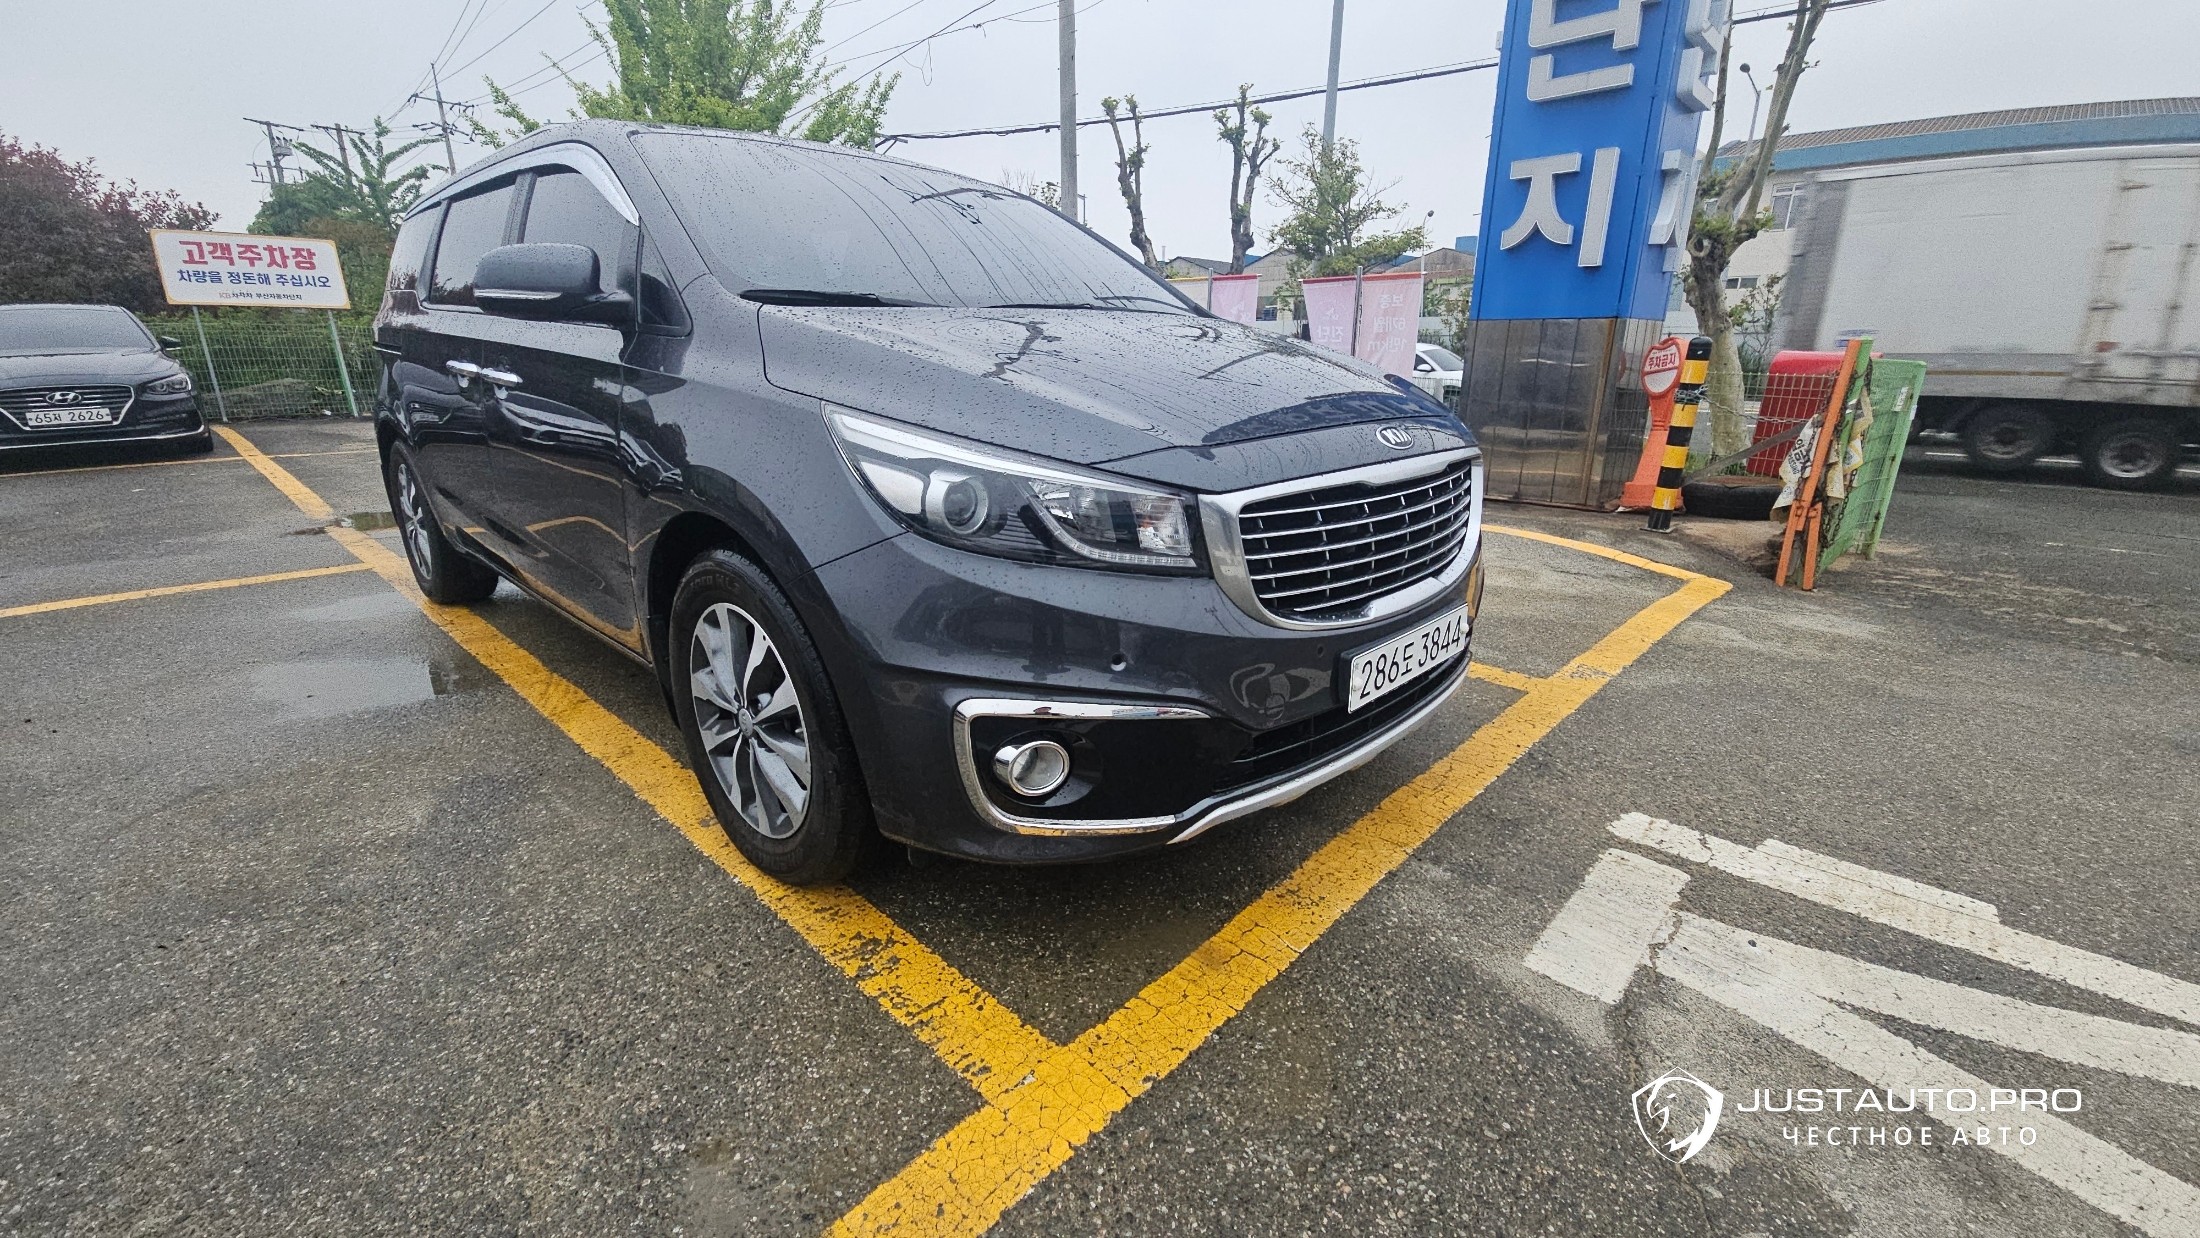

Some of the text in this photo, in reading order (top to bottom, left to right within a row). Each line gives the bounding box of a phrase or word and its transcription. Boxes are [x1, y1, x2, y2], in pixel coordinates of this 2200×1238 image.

[179, 240, 317, 271] 고객주차장
[177, 269, 331, 288] 차량을 정돈해 주십시오
[1648, 352, 1676, 369] 주차금지
[68, 411, 104, 422] 2626
[1359, 614, 1462, 700] 286도 3844
